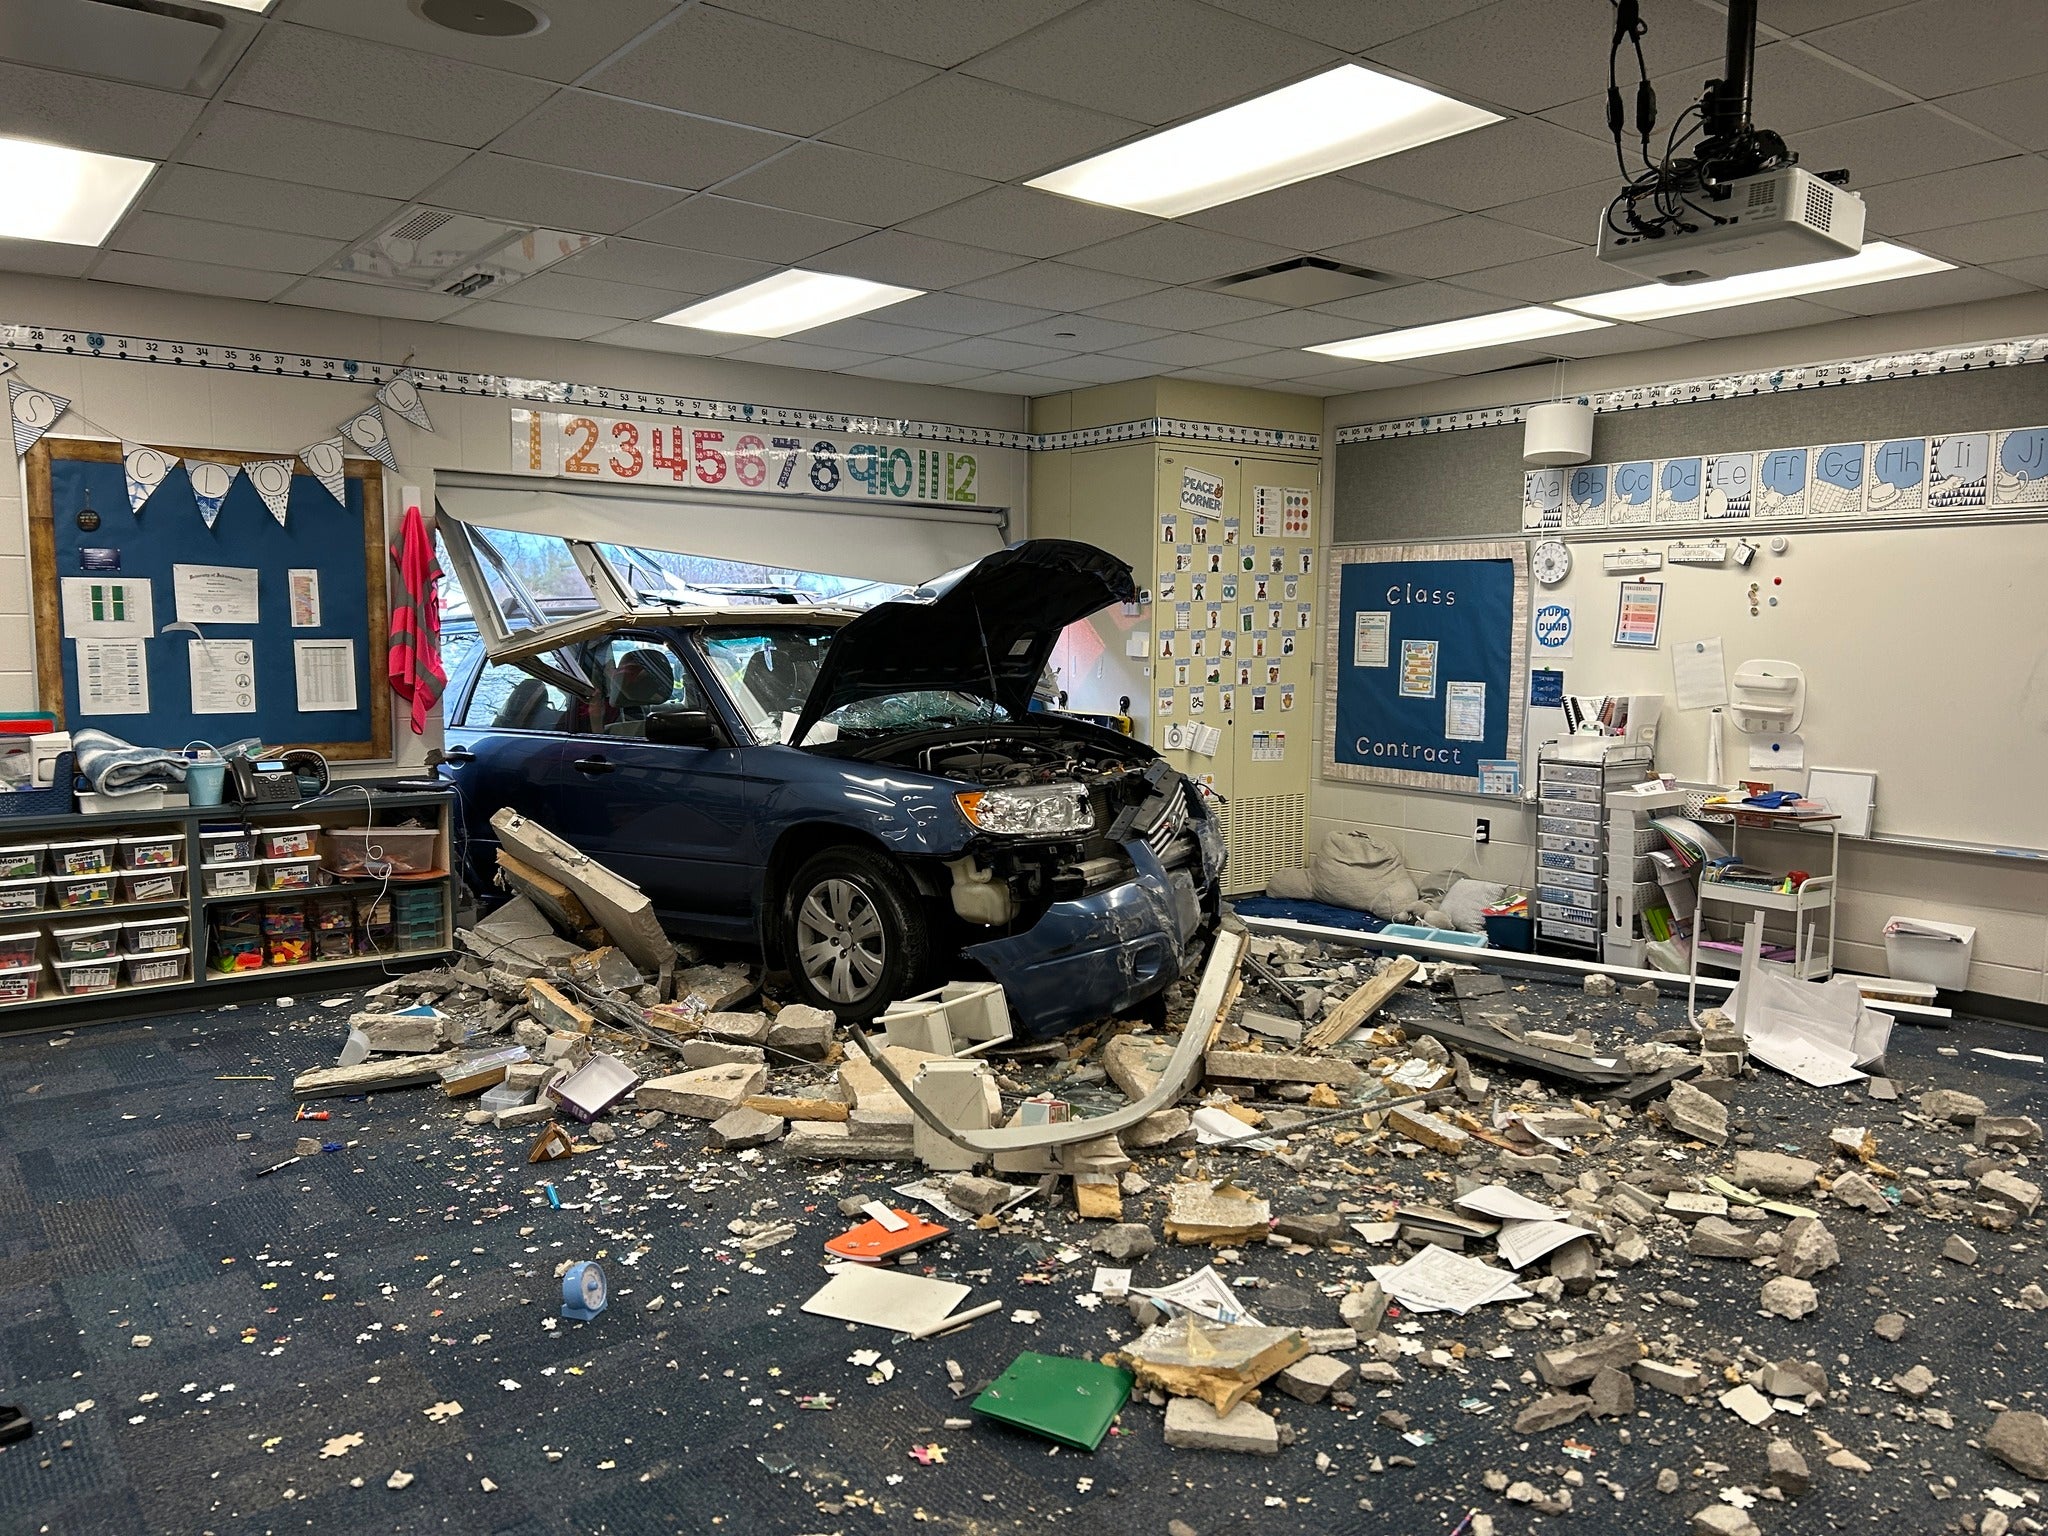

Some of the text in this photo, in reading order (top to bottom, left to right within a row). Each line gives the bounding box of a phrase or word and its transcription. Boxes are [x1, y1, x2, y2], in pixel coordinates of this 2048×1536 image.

[26, 395, 44, 422] S
[530, 411, 976, 502] 1 2 3 4 5 6 7 8 9 10 11 12
[1534, 436, 2044, 498] Aa Bb Cc Dd Ee Ff Gg Hh Ii Jj
[1184, 476, 1214, 495] PEACE
[1182, 491, 1220, 510] CORNER
[1617, 556, 1648, 566] Tuesday
[1682, 549, 1711, 558] January
[1386, 583, 1456, 606] Class
[1538, 608, 1570, 617] STUPID
[1539, 623, 1567, 631] DUMB
[1540, 638, 1566, 646] IDIOT
[1356, 736, 1461, 764] Contract
[68, 855, 101, 863] Counters
